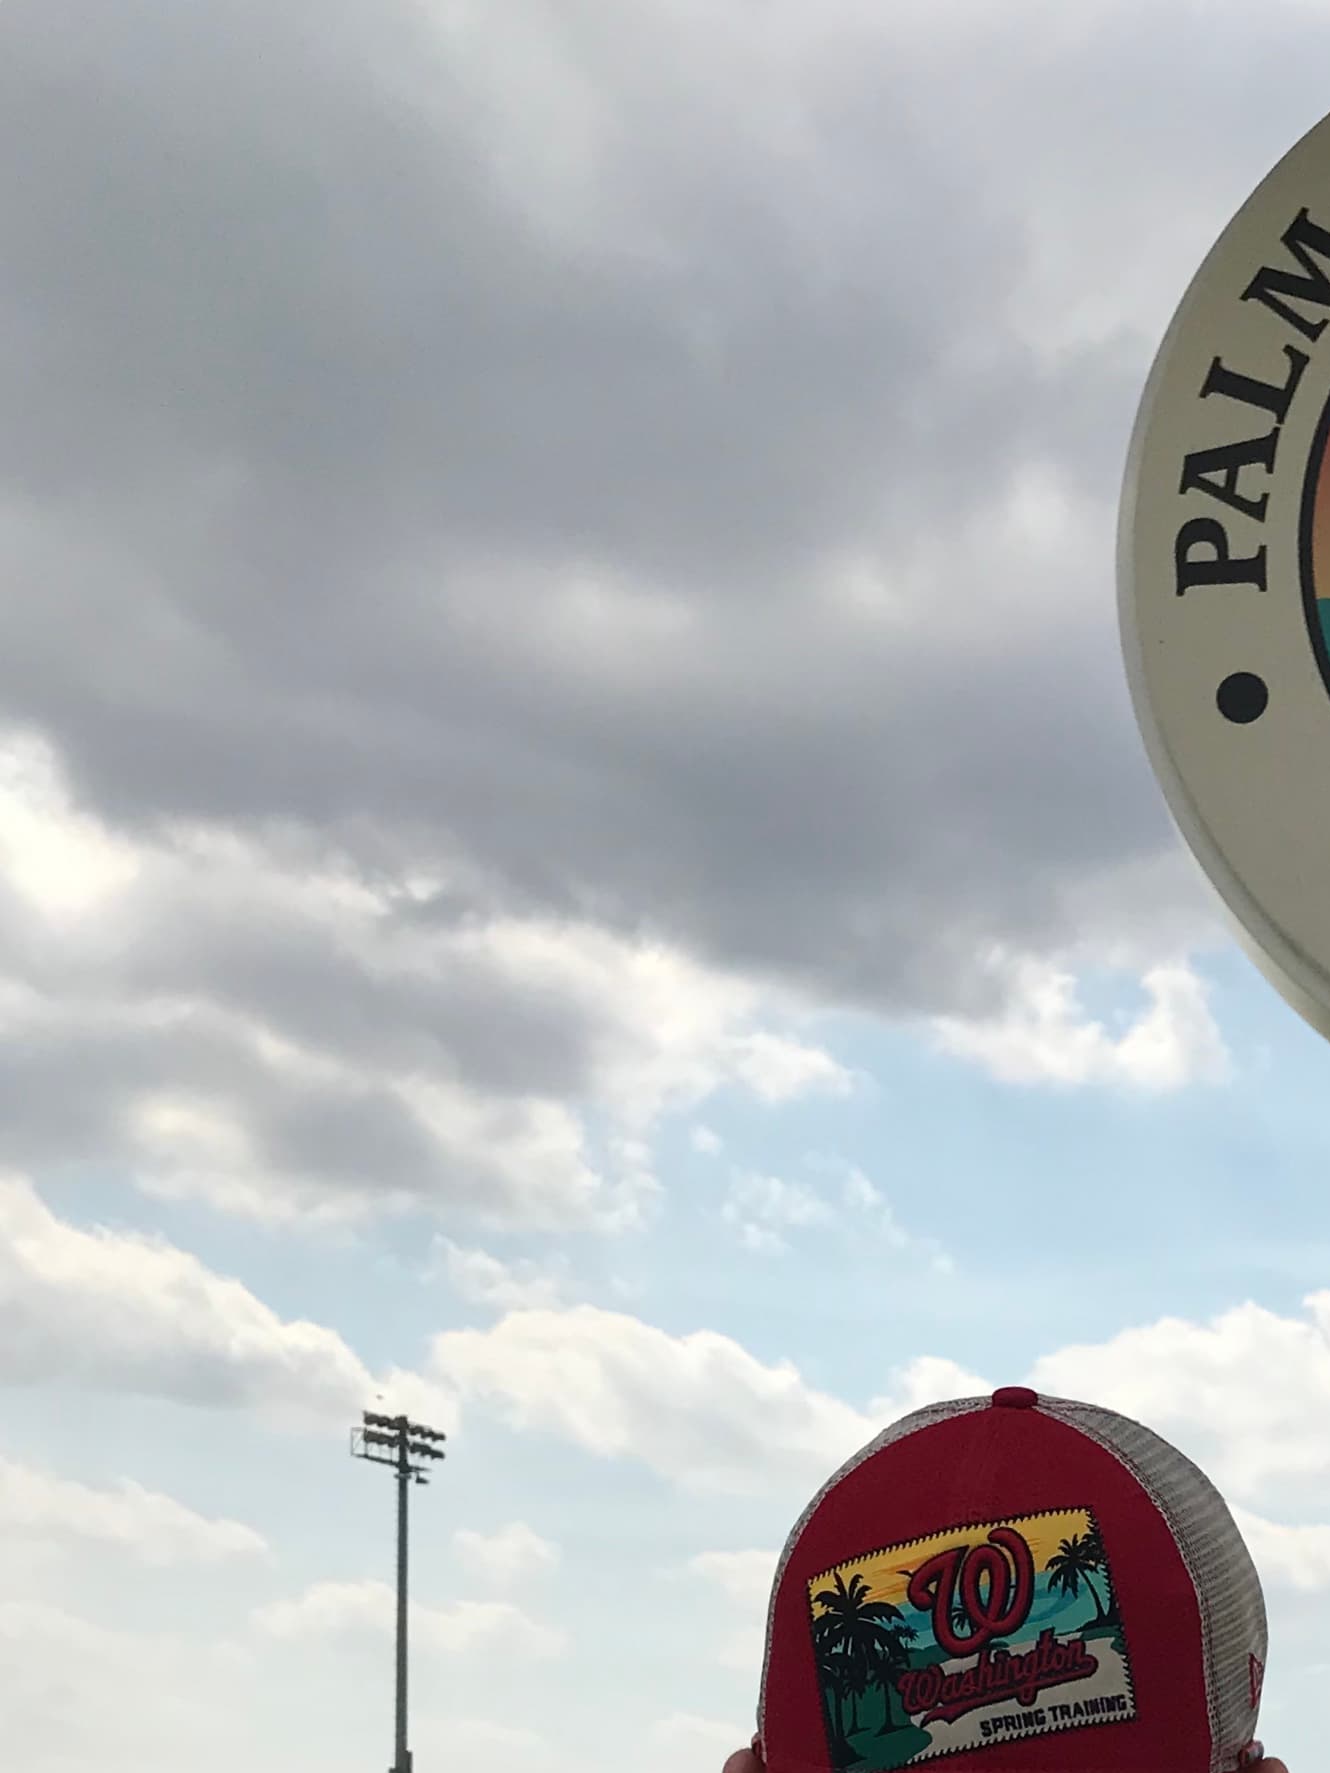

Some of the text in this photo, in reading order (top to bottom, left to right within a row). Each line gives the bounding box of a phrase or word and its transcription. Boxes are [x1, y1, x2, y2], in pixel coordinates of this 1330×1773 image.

[897, 1627, 1098, 1728] Washington
[980, 1695, 1126, 1738] SPRING TRAINING
